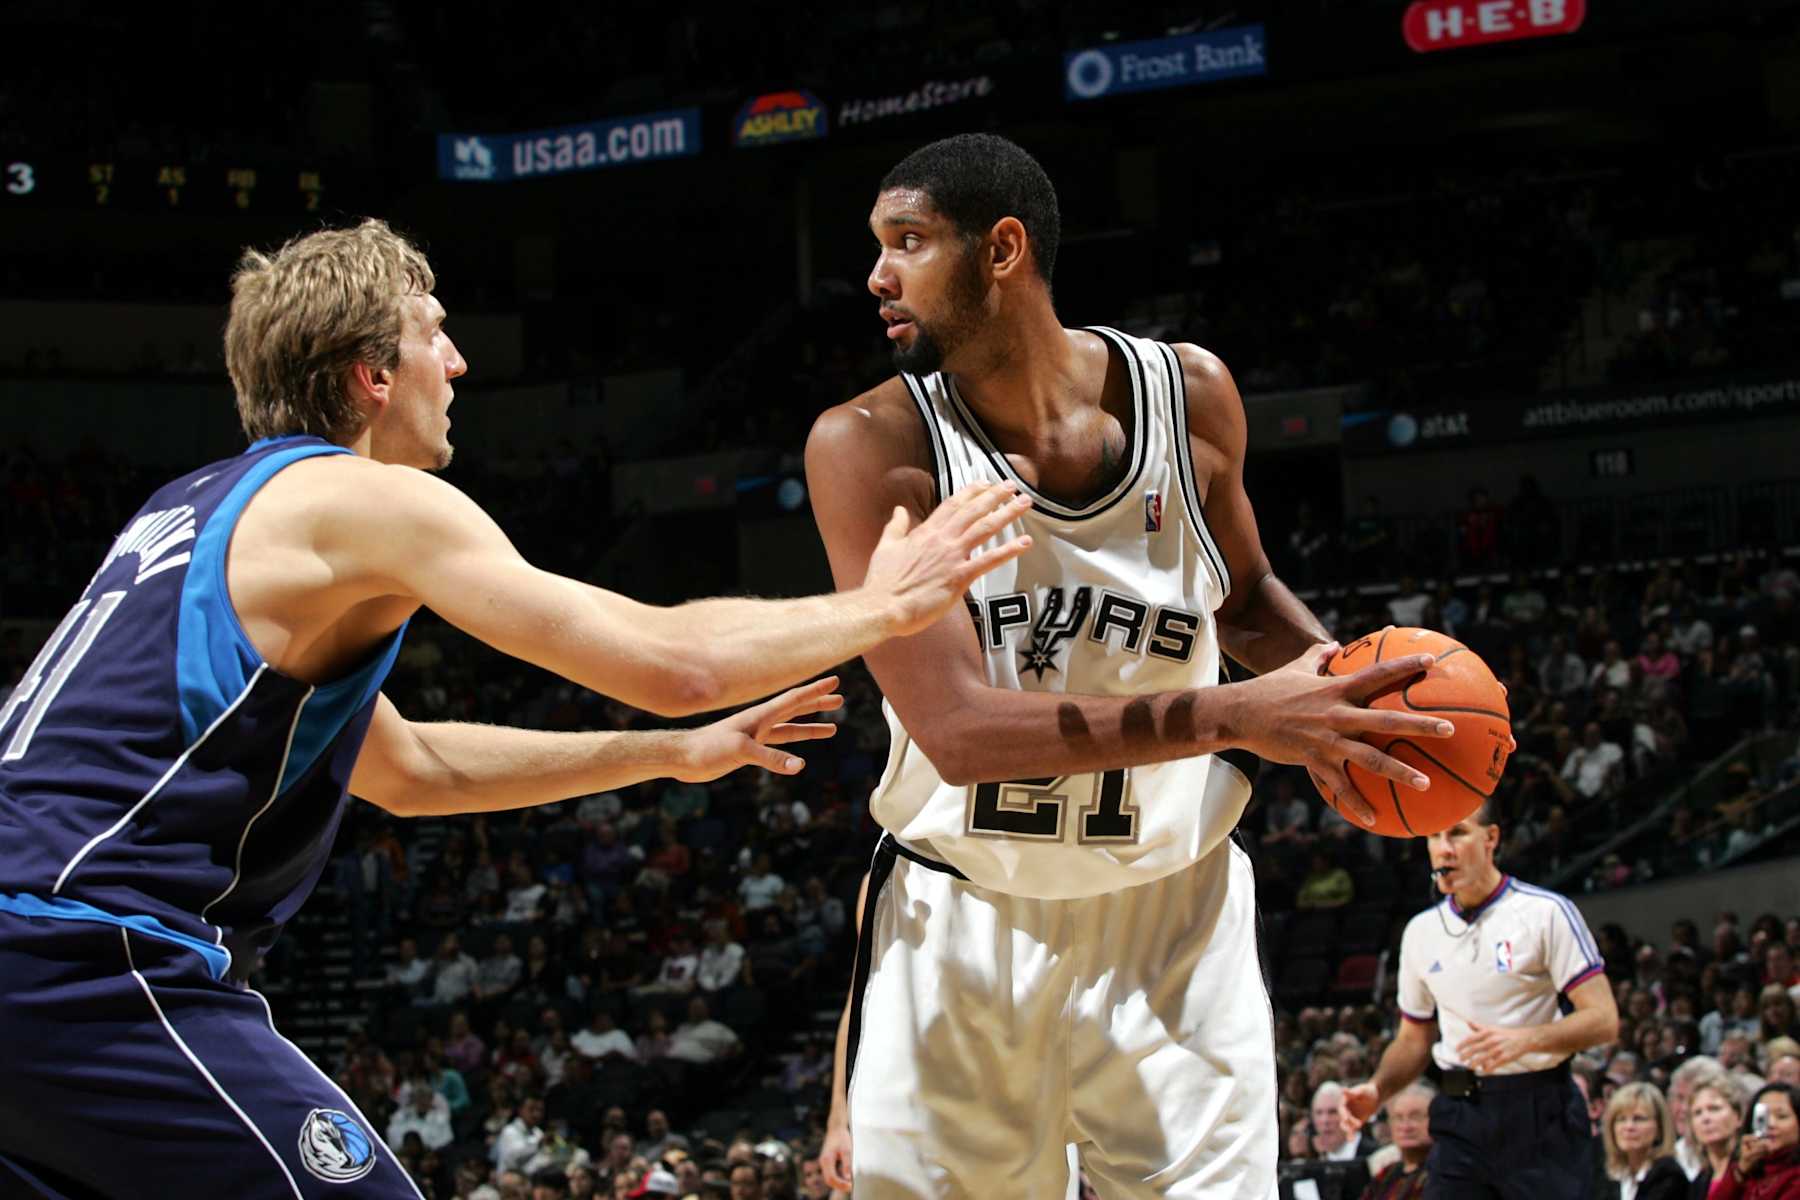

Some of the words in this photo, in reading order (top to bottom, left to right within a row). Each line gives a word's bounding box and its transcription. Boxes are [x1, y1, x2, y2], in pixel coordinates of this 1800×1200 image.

[1119, 52, 1186, 84] Frost
[1194, 35, 1263, 73] Bank
[837, 76, 992, 128] HomeStore
[512, 118, 686, 176] usaa.com
[8, 163, 36, 195] 3
